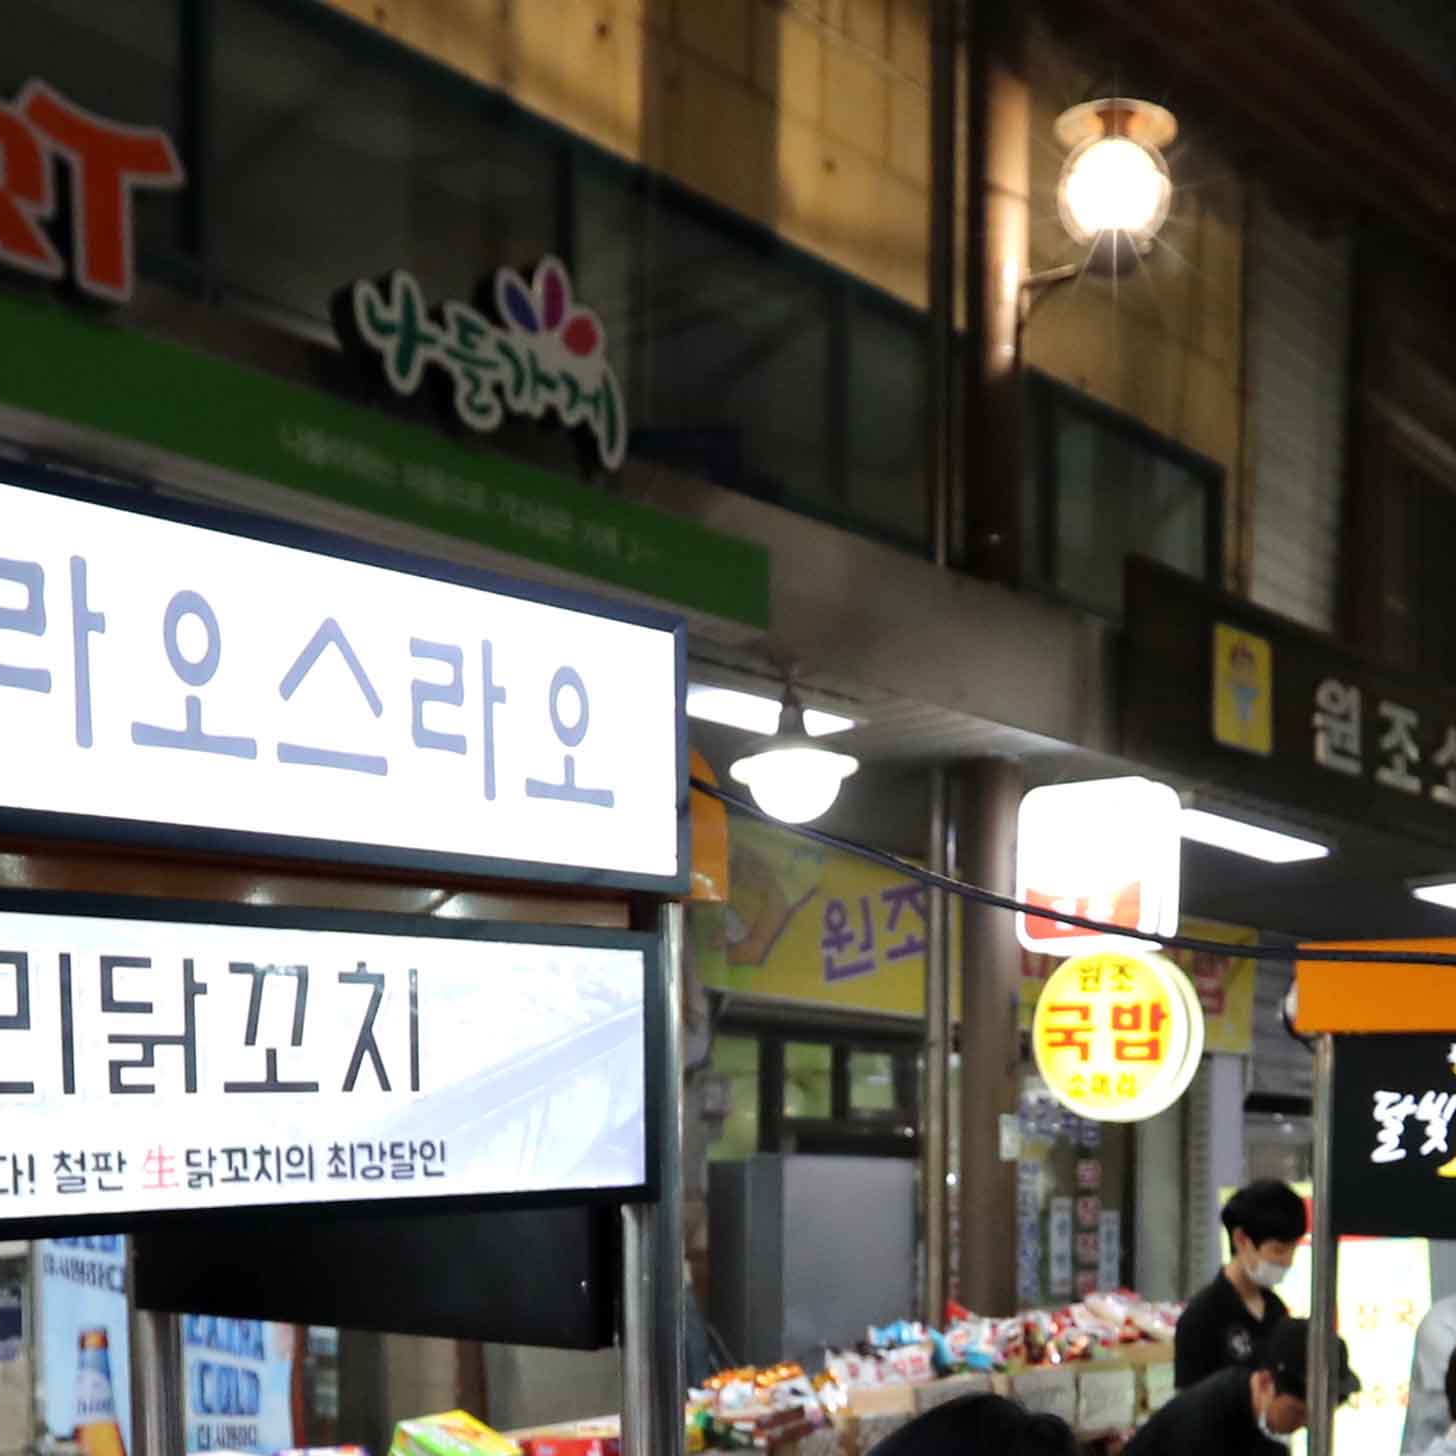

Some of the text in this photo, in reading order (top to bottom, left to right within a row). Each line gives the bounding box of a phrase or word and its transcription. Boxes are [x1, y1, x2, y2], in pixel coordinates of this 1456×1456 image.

[1044, 1001, 1169, 1063] 국밥
[52, 1149, 127, 1194] 철판
[326, 1138, 446, 1181] 최강달인
